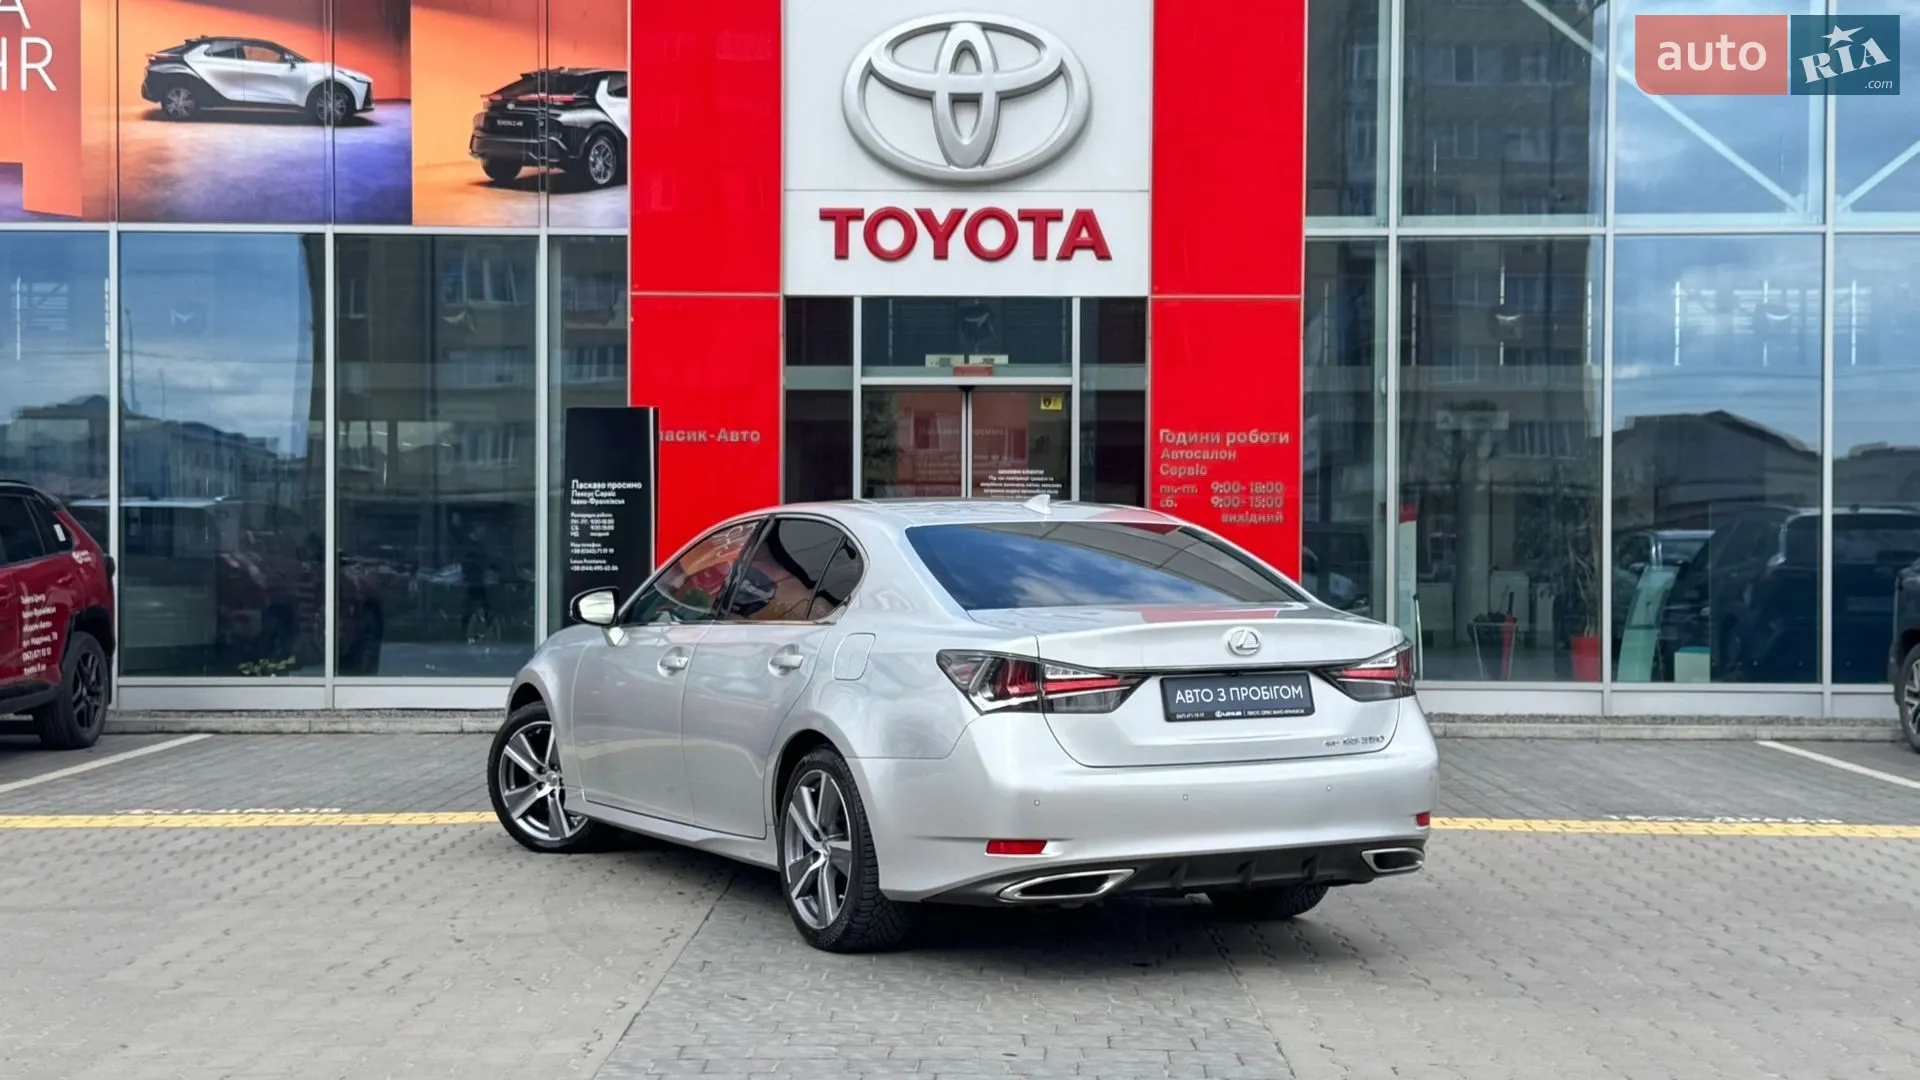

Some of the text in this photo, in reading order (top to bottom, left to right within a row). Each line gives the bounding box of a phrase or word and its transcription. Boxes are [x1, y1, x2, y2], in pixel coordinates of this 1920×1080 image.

[819, 207, 1113, 262] TOYOTA
[1159, 428, 1290, 447] Години роботи
[1160, 448, 1237, 460] Автосалон
[607, 481, 643, 490] просимо
[1159, 497, 1178, 508] сб.
[1175, 688, 1214, 704] АВТО
[1229, 685, 1304, 701] ПРОБІГОМ
